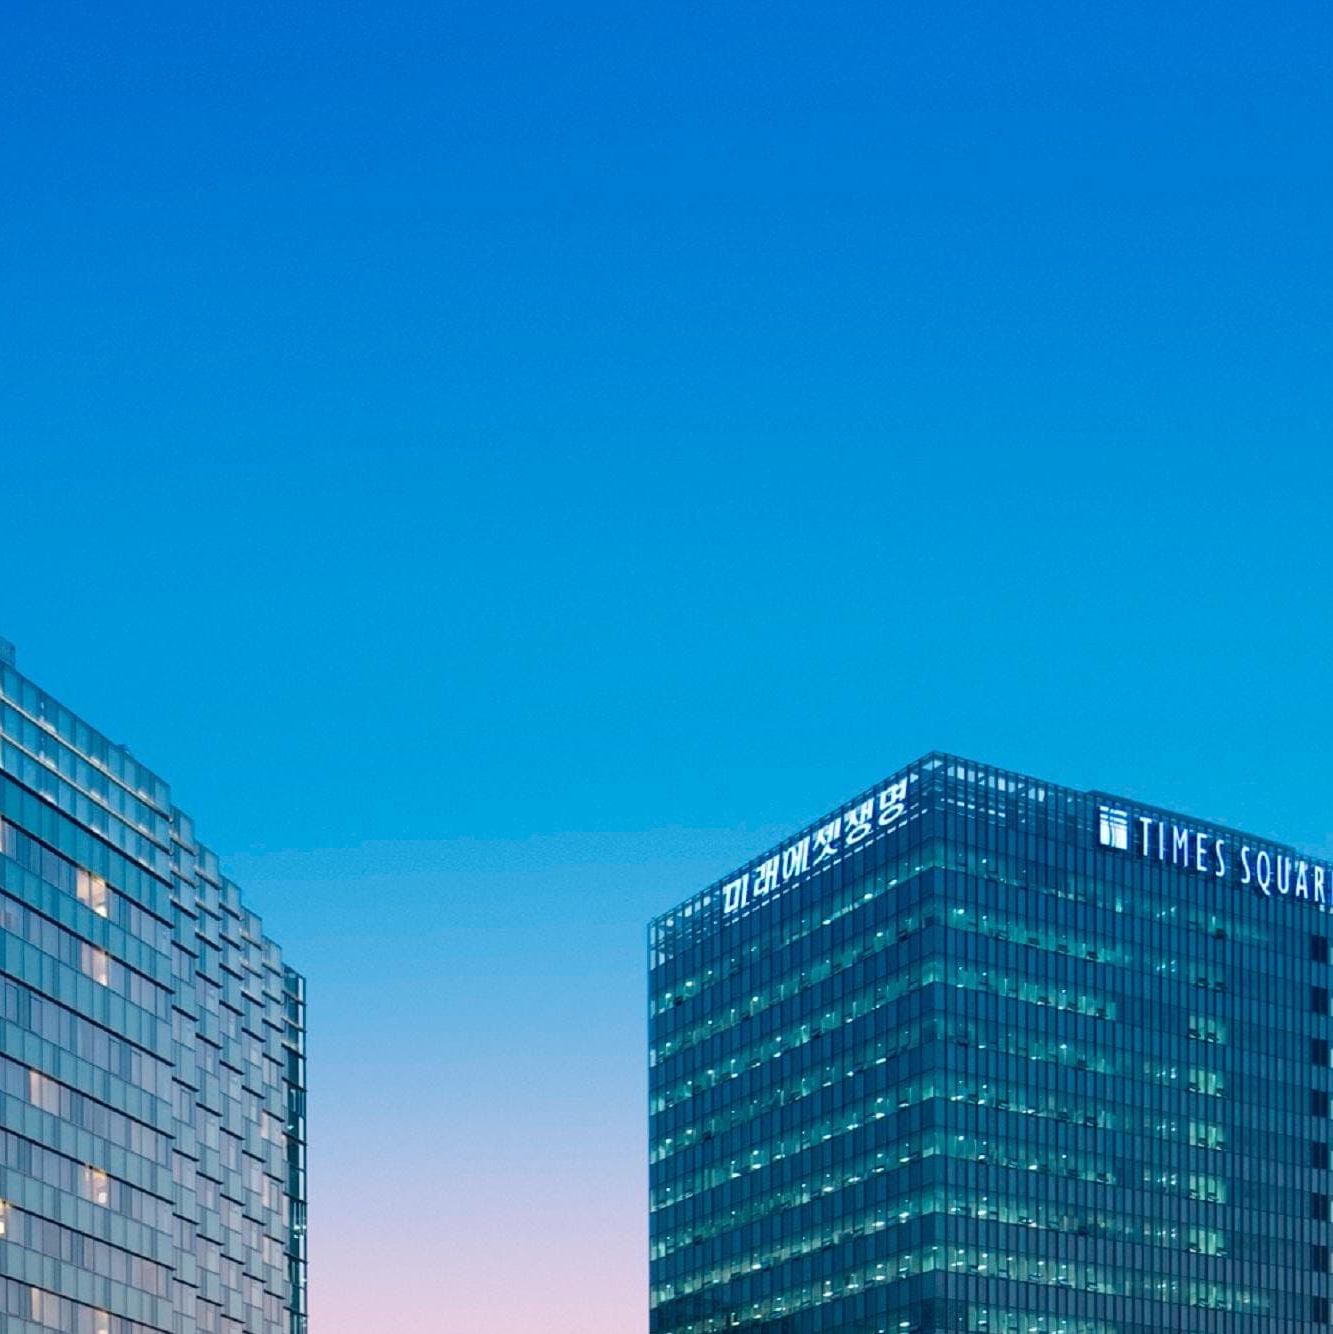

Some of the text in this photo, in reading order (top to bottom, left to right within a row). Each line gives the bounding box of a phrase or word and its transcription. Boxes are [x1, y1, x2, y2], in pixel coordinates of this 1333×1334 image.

[722, 776, 908, 914] 미래에셋생명
[1139, 816, 1333, 904] TIMES SQUAR
